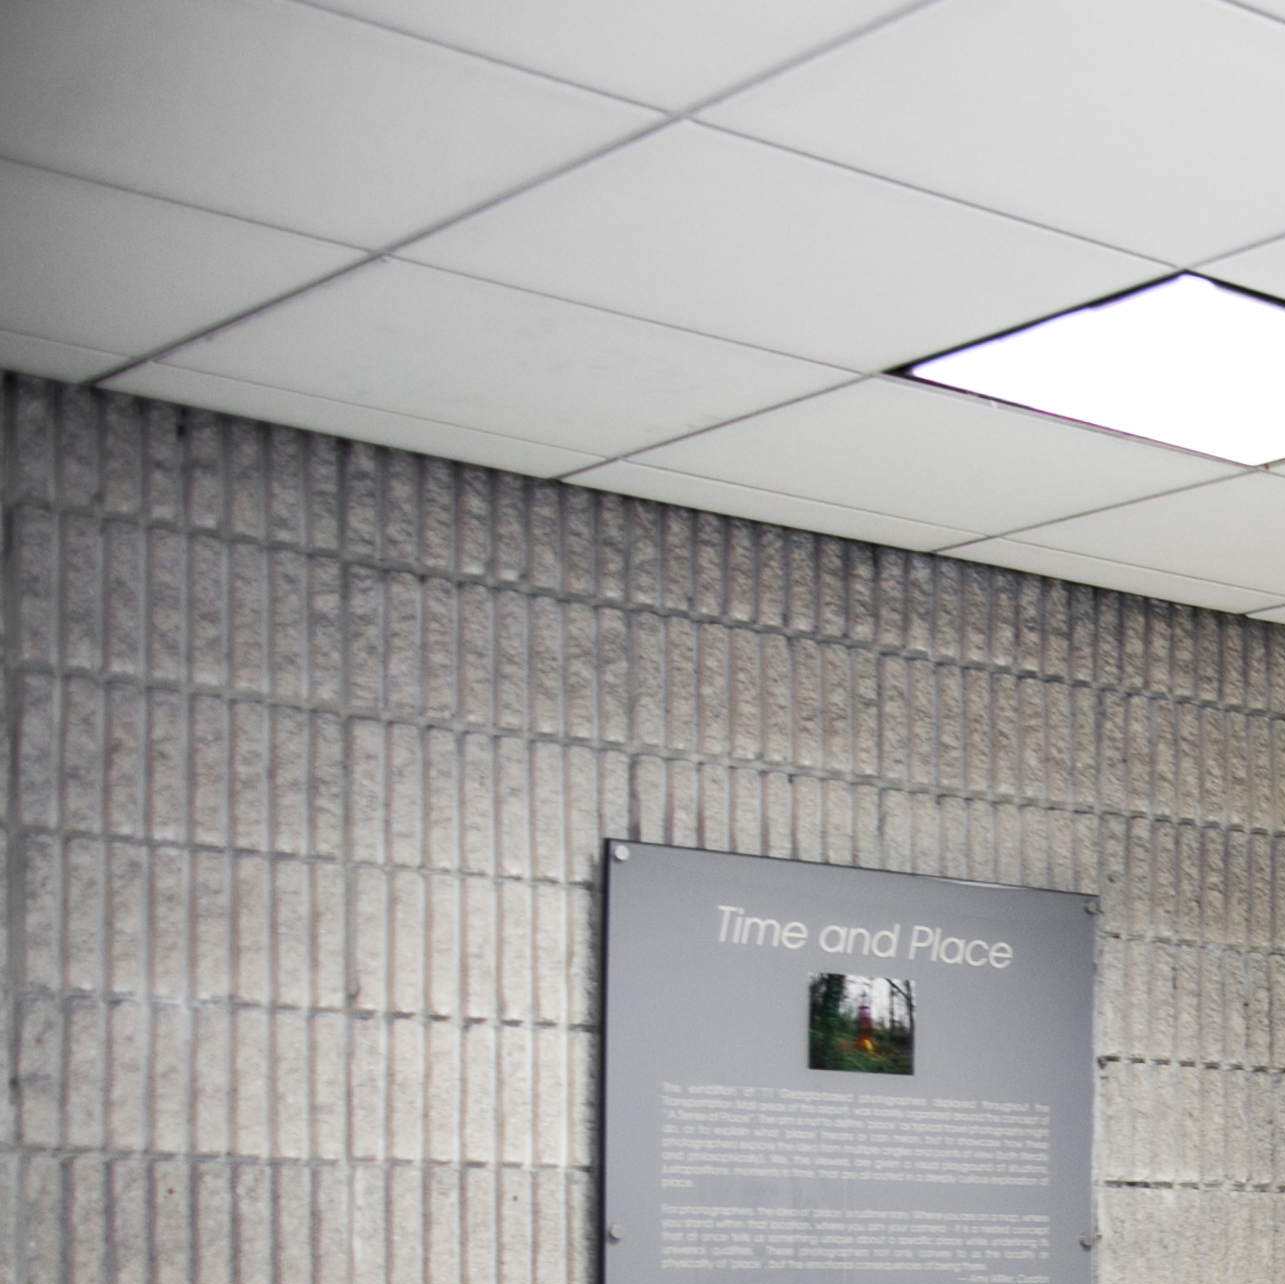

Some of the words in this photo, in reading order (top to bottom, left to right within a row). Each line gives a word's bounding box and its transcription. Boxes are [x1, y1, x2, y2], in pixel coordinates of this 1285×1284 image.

[717, 904, 809, 951] Time
[818, 923, 901, 958] and
[908, 925, 1014, 969] Place
